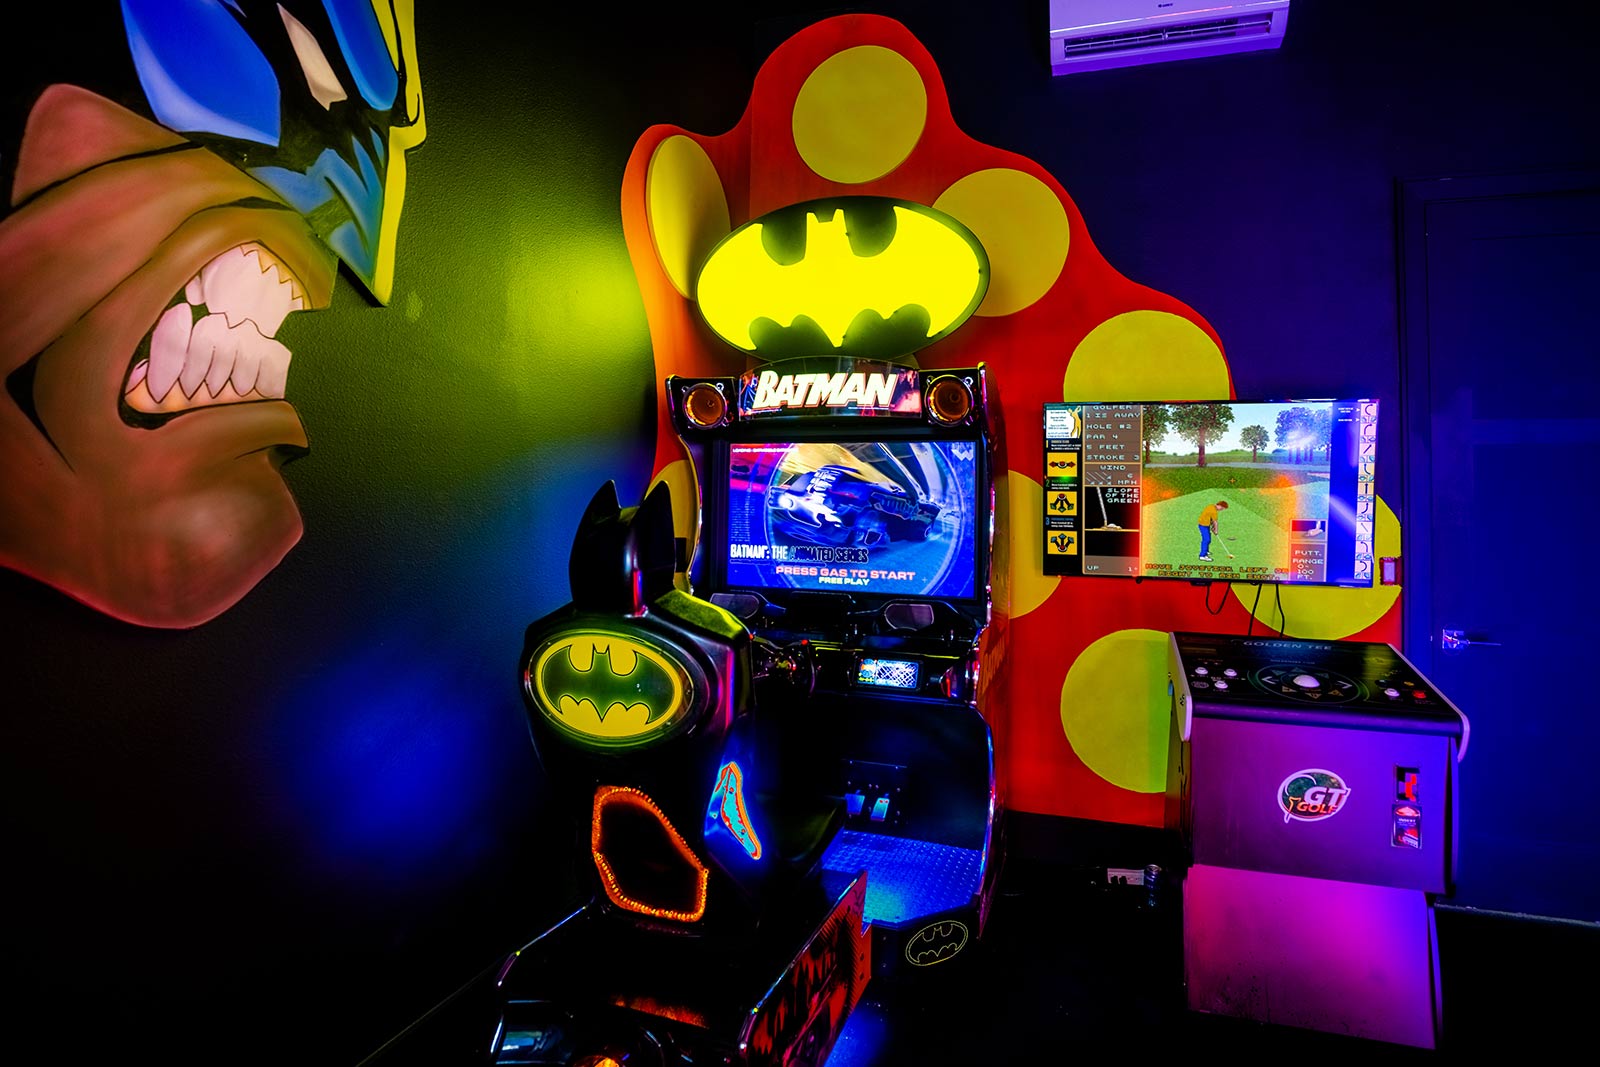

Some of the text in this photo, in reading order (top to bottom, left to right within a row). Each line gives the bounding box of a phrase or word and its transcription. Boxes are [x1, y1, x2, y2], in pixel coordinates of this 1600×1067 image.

[751, 370, 899, 411] BATMAN
[771, 545, 788, 560] THE
[775, 565, 916, 581] PRESS GAS TO START
[818, 576, 870, 586] FREE PLAY
[1243, 641, 1302, 649] GOLDEN
[1304, 786, 1347, 807] GT
[1296, 801, 1339, 814] GOLF
